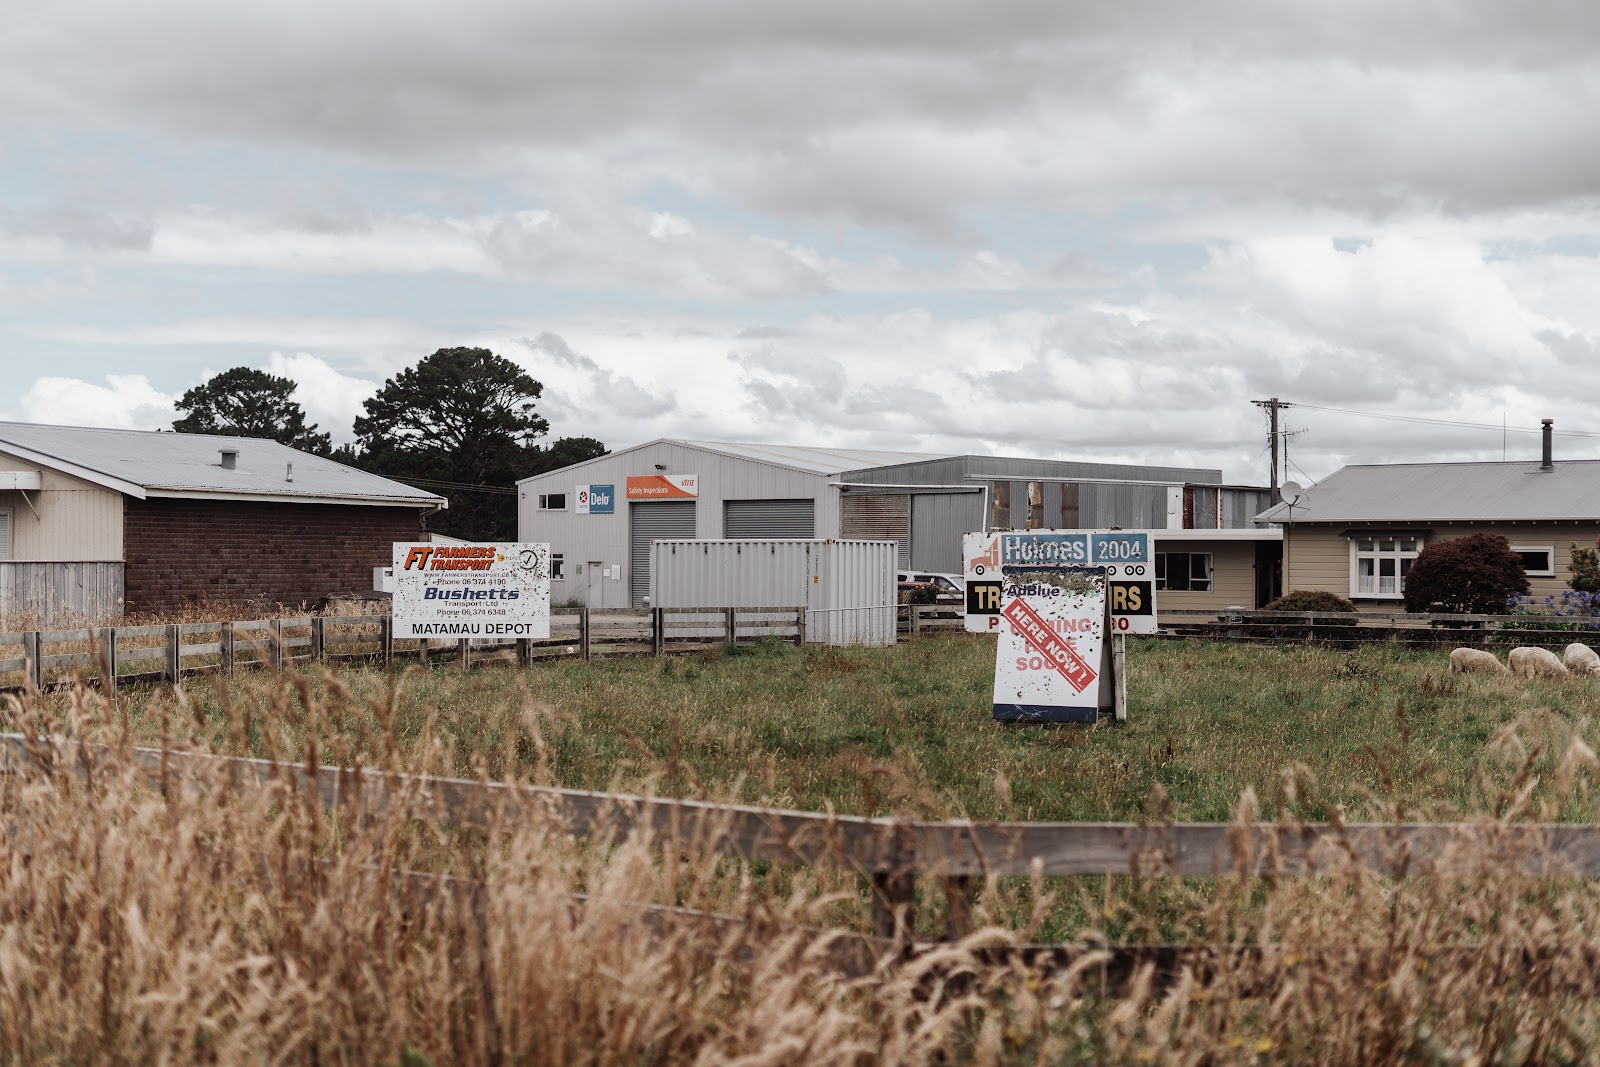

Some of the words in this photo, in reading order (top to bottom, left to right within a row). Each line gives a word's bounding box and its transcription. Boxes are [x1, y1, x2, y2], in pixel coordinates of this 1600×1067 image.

[628, 487, 643, 495] Safety
[643, 487, 669, 495] Inspections
[590, 492, 609, 505] Delo
[433, 547, 496, 558] FARMERS
[1005, 537, 1085, 561] Holmes
[1098, 540, 1142, 560] 2004
[404, 547, 434, 570] FT
[430, 560, 494, 570] TRANSPORT
[424, 588, 519, 600] Bushetts
[1006, 585, 1060, 597] AdBlue
[412, 624, 480, 634] MATAMAU
[486, 624, 532, 634] DEPOT
[1010, 605, 1048, 643] HERE
